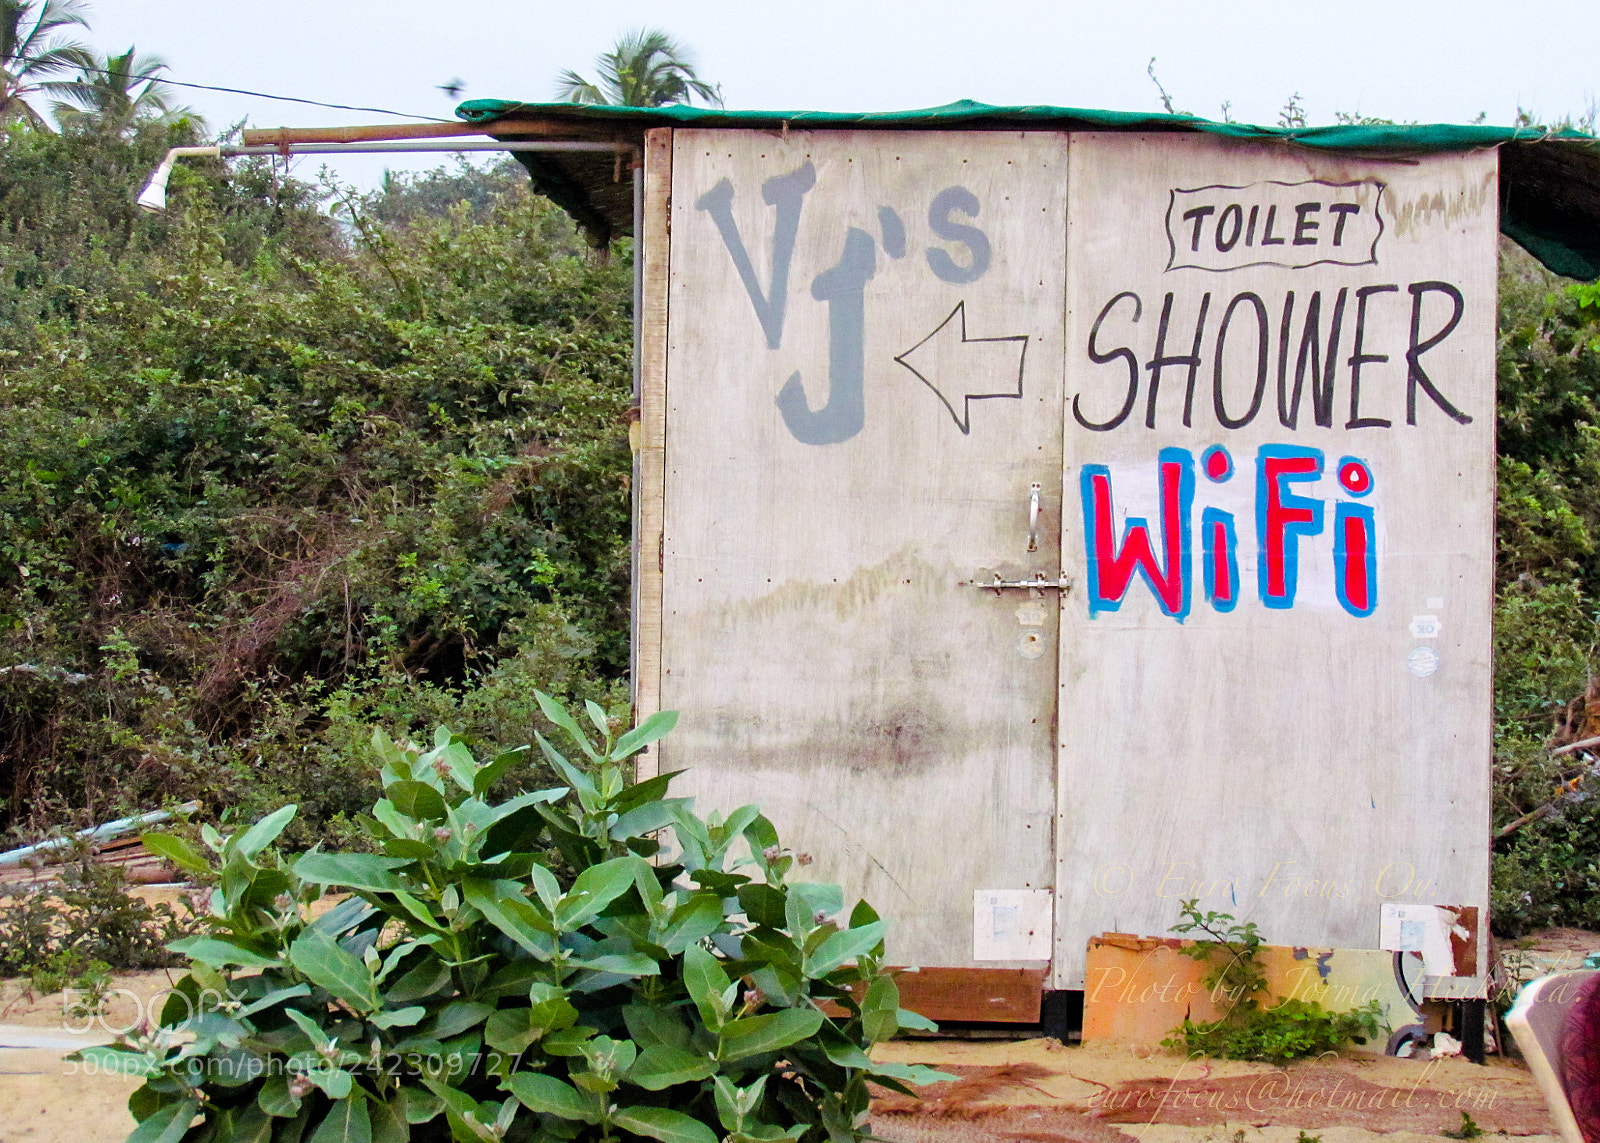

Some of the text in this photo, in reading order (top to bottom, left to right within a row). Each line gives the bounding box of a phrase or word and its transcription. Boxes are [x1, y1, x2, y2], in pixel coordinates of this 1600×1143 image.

[1182, 201, 1360, 253] TOILET
[1072, 280, 1474, 431] SHOWER
[1079, 443, 1378, 624] WiFi
